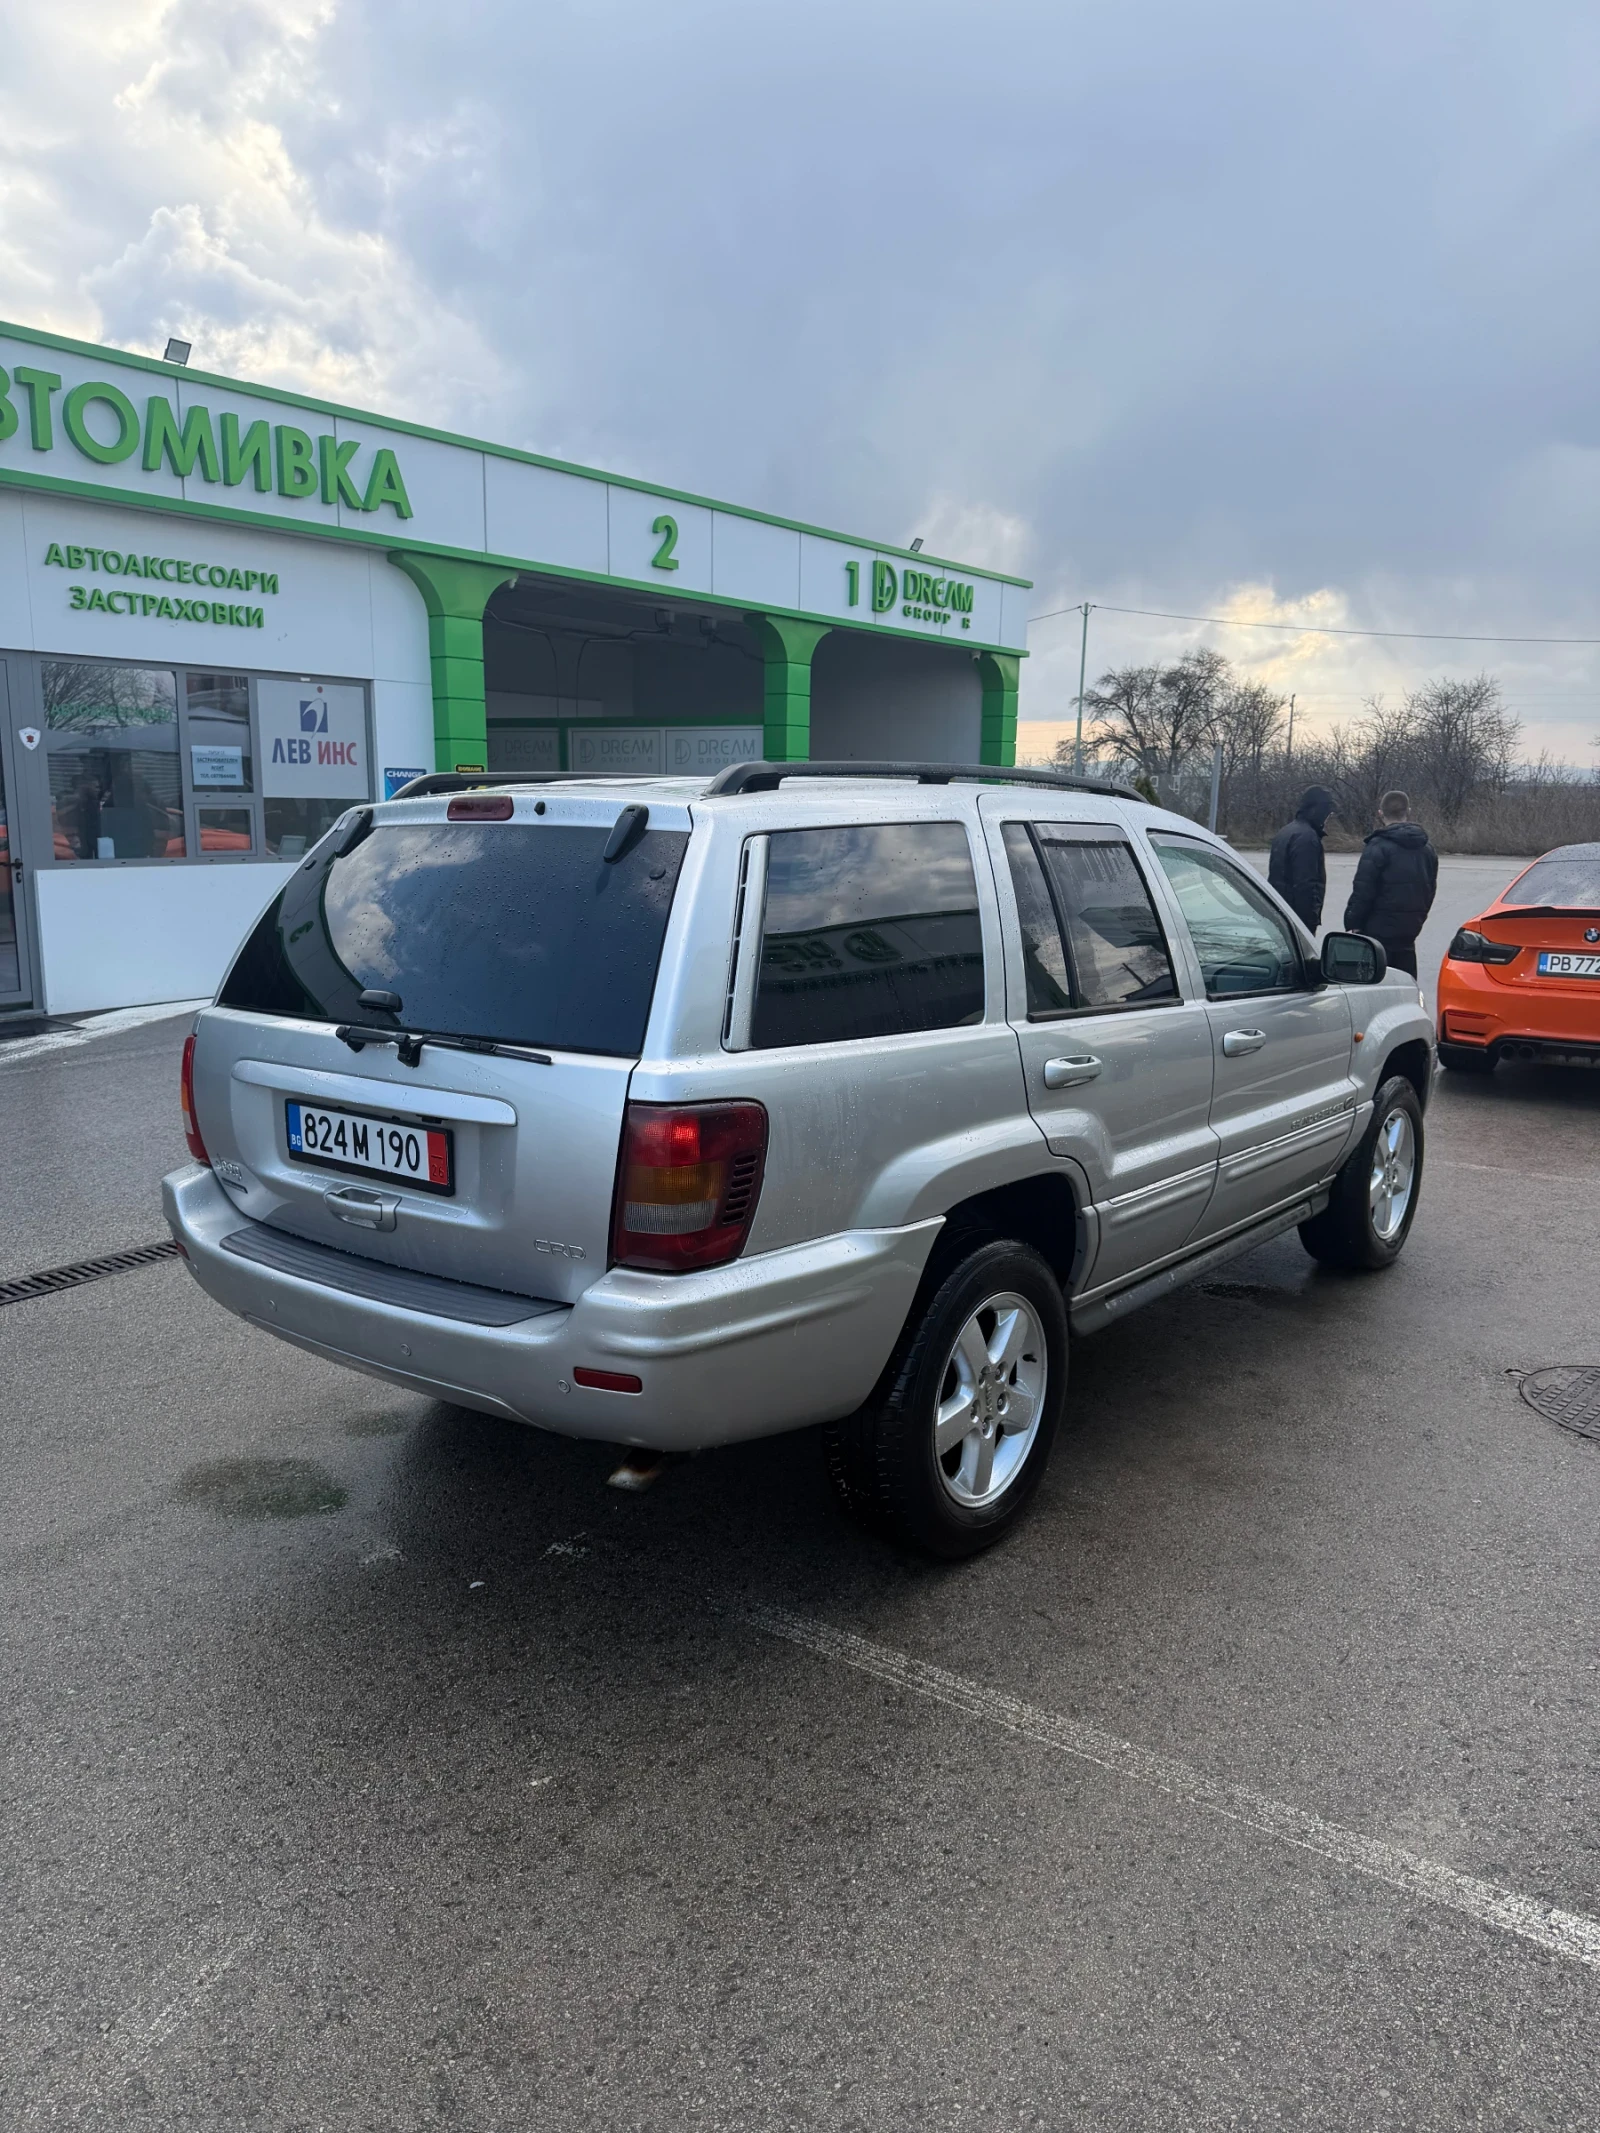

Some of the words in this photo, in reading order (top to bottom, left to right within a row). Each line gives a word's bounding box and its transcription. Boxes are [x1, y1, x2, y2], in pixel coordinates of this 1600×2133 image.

[652, 515, 679, 570] 2
[44, 543, 279, 595] АВТОАКСЕСОАРИ
[845, 561, 859, 607] 1
[903, 569, 974, 613] DREAM
[69, 586, 264, 628] ЗАСТРАХОВКИ
[903, 605, 951, 624] GROUP
[961, 617, 971, 629] R
[272, 738, 312, 764] ЛЕВ
[318, 740, 358, 766] ИНС
[601, 738, 653, 755] DREAM
[698, 738, 756, 755] DREAM
[1550, 956, 1572, 971] PB
[291, 1133, 302, 1146] BG
[304, 1113, 347, 1156] 824
[352, 1121, 369, 1161] M
[376, 1128, 420, 1171] 190
[432, 1164, 445, 1178] 26
[533, 1239, 587, 1260] CRD
